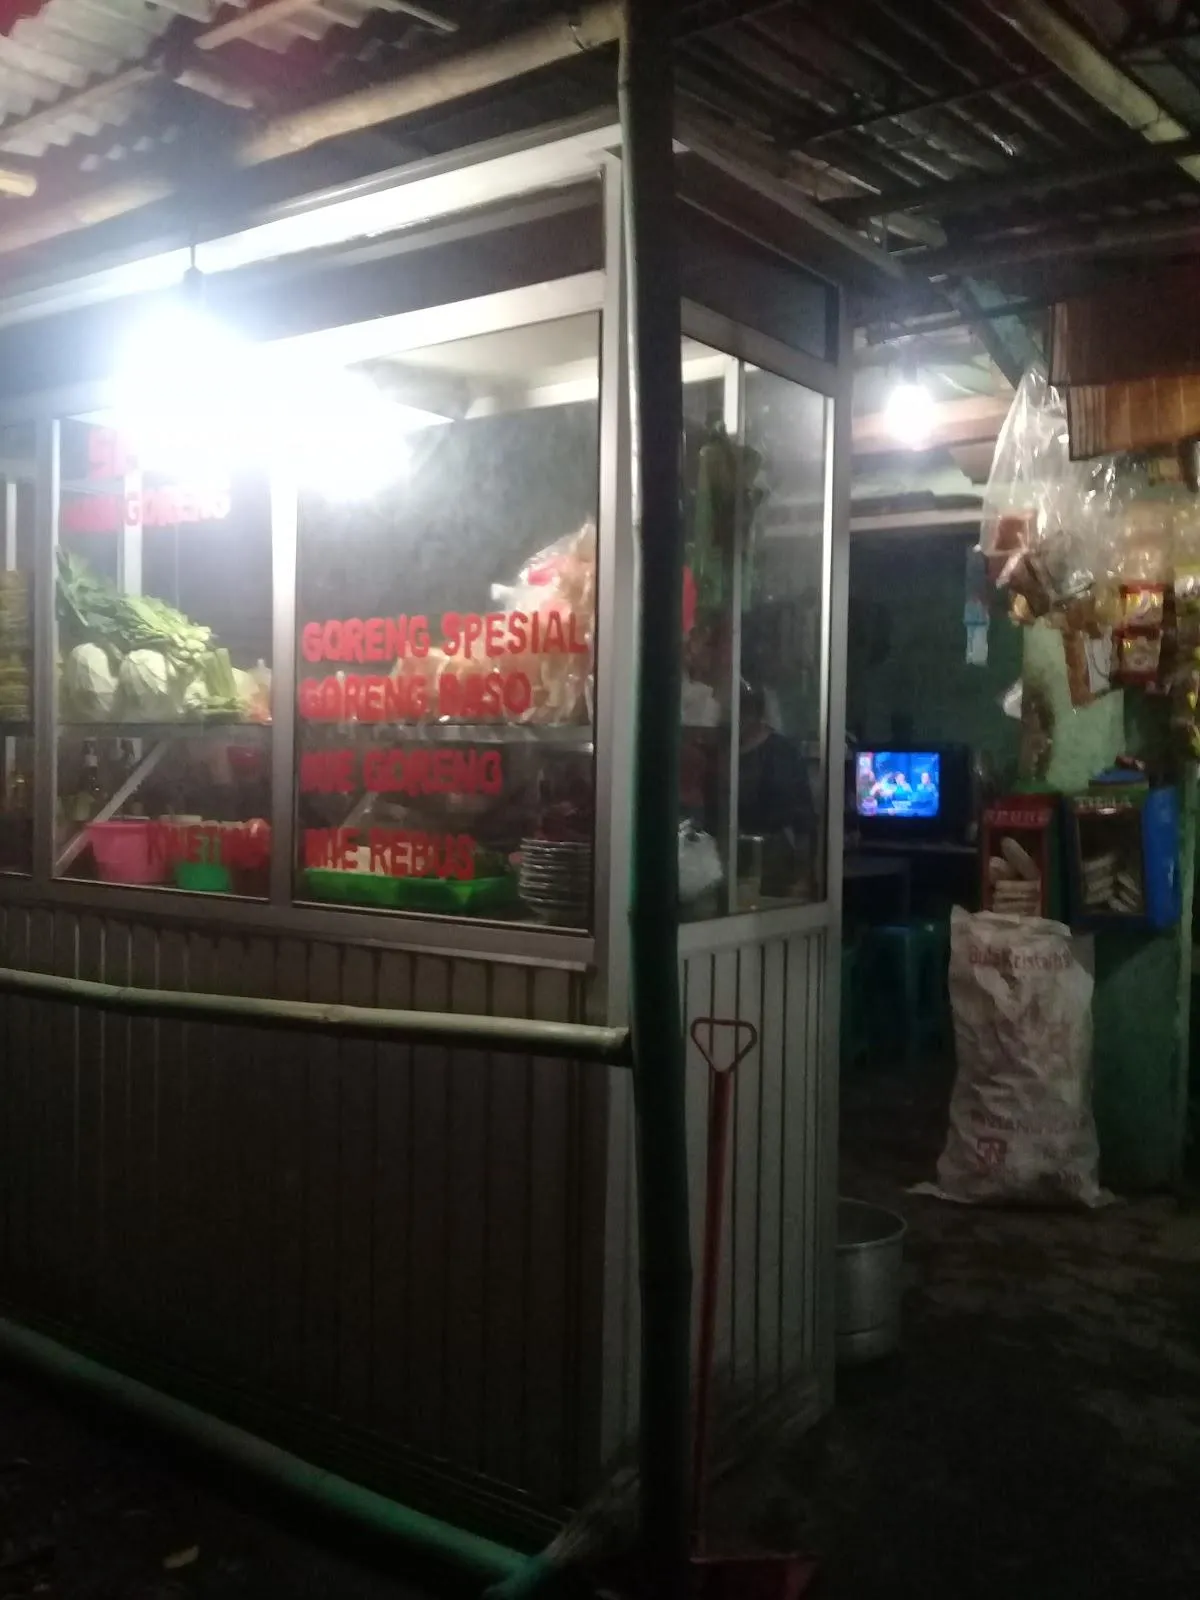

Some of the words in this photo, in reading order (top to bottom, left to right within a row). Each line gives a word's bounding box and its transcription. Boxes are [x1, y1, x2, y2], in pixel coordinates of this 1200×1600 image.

[302, 614, 429, 662] GORENG
[441, 610, 588, 659] SPESIAL
[300, 674, 428, 721] GORENG
[363, 748, 502, 797] GORENG
[369, 828, 475, 880] REBUS
